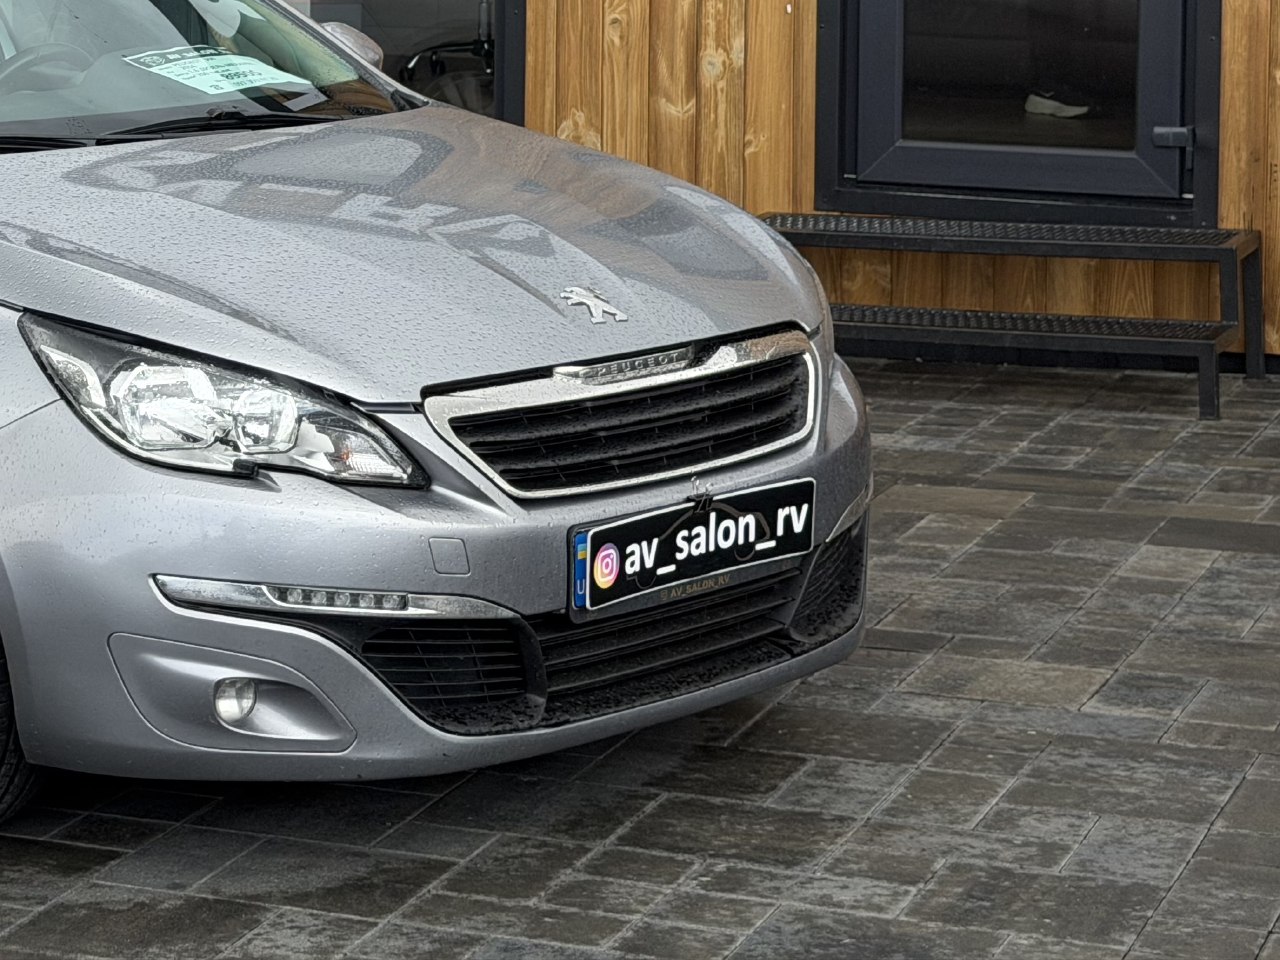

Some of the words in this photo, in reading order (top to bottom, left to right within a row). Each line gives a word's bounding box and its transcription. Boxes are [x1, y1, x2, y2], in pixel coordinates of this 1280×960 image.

[597, 352, 679, 377] PEUGEOT
[624, 503, 809, 576] av_salon_rv
[670, 573, 731, 598] AV_SALON_RV
